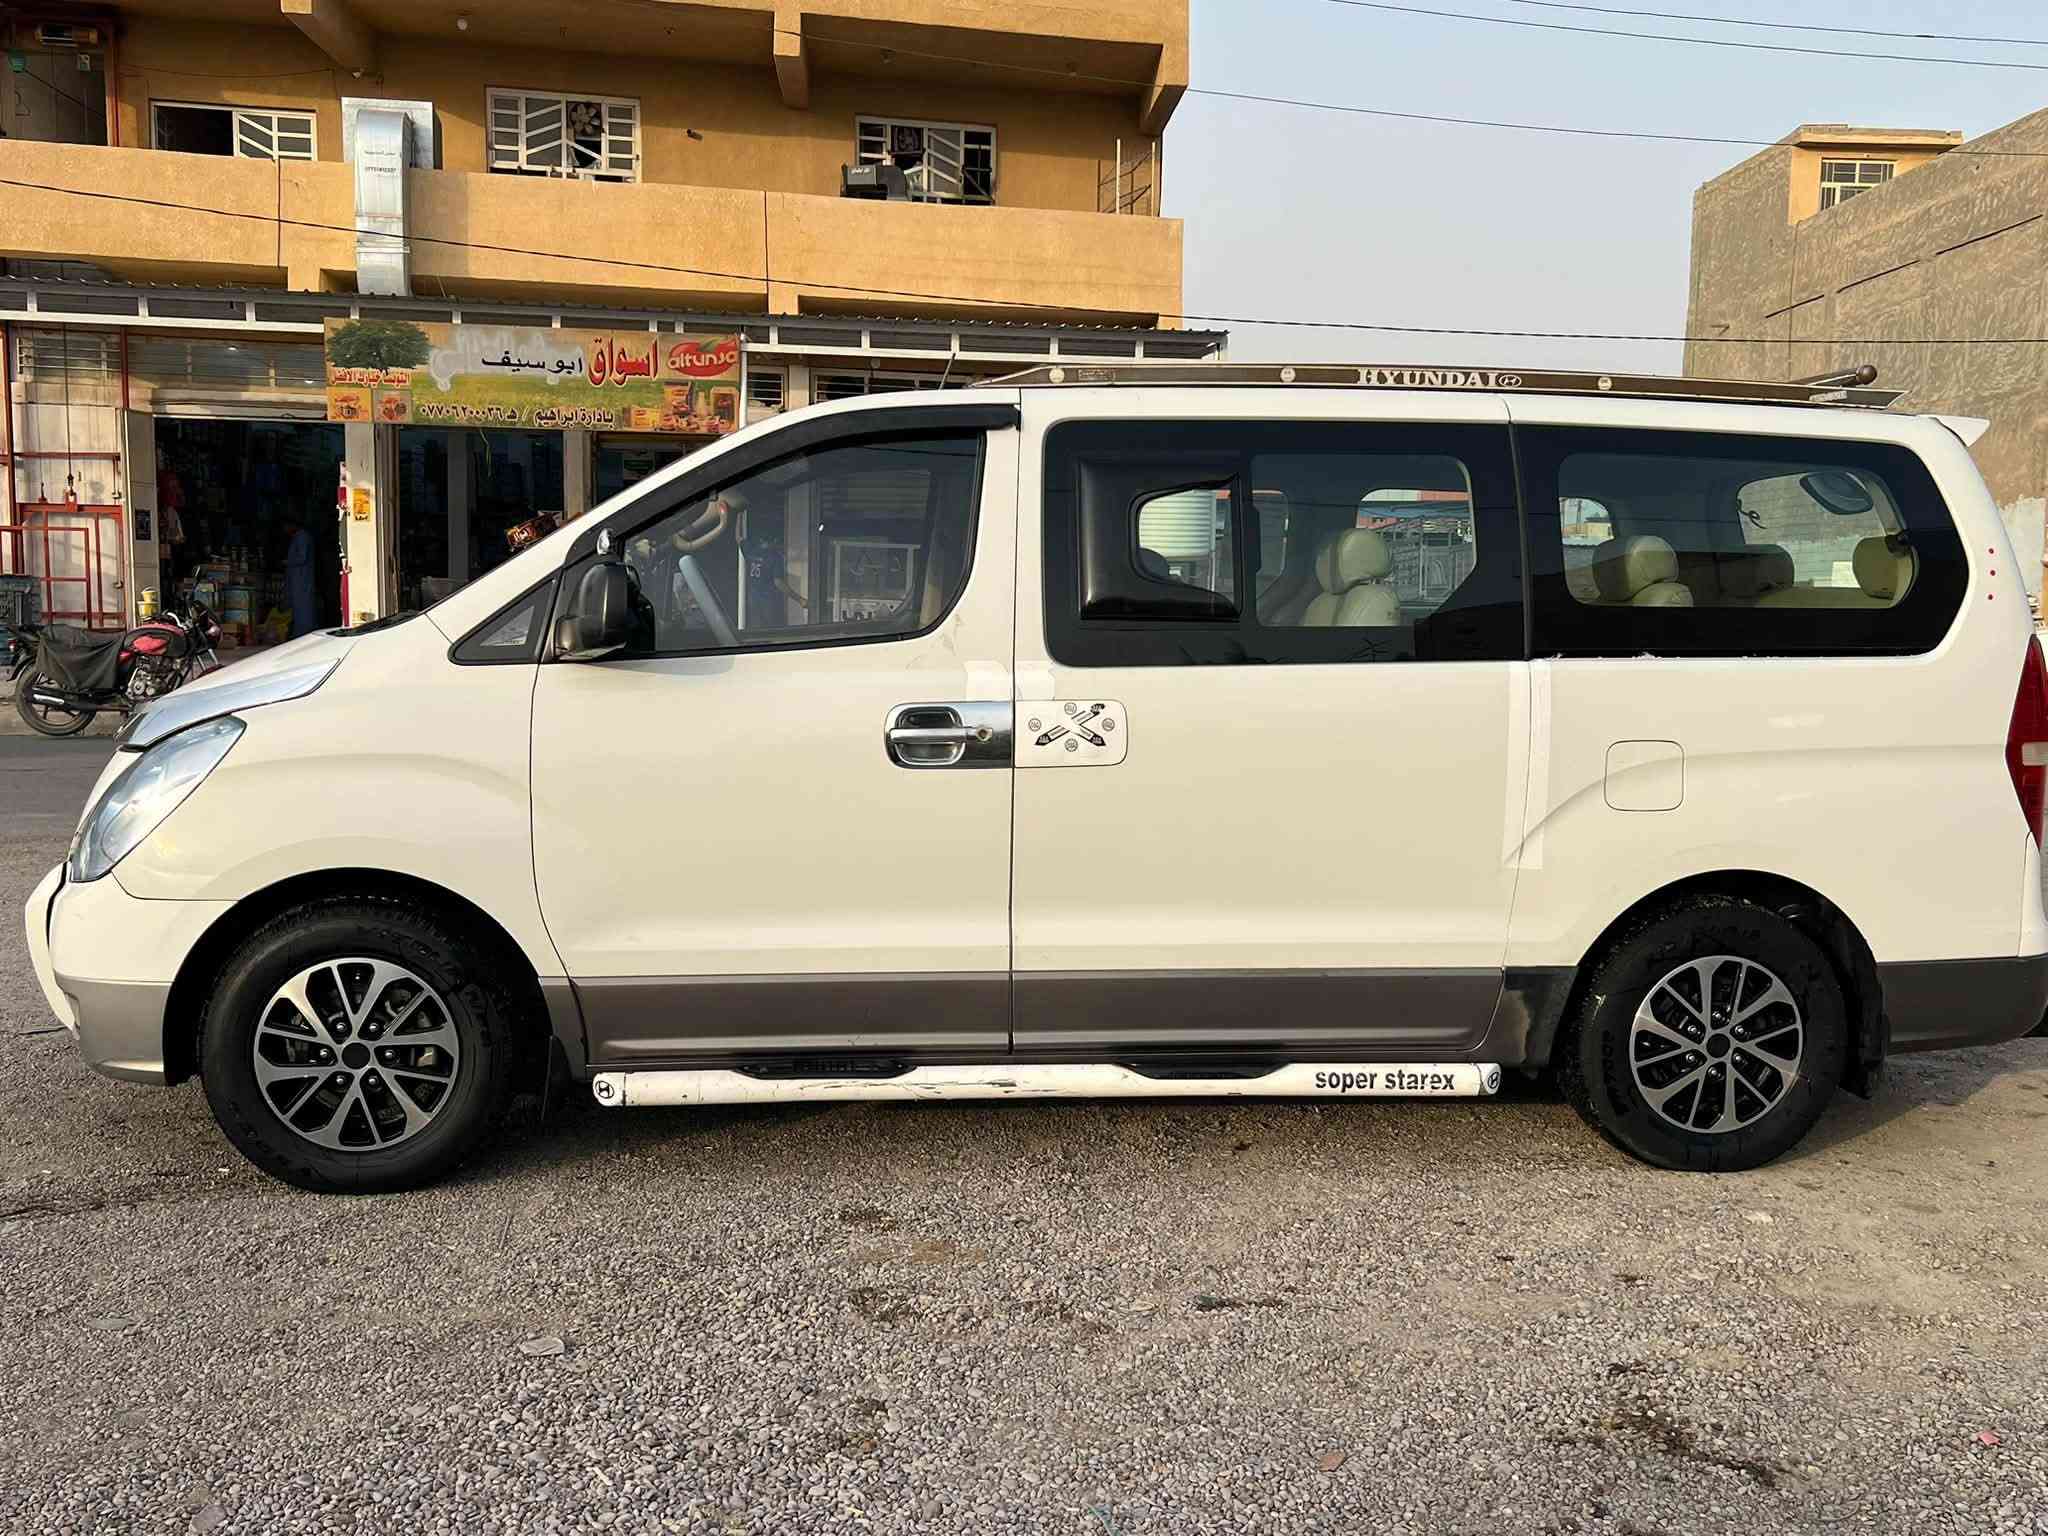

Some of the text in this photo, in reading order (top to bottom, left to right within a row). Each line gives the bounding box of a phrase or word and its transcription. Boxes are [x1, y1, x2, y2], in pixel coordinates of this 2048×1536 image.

[481, 335, 659, 386] اسواق ابو سيف
[1357, 367, 1500, 388] HYUNDAI
[535, 407, 578, 427] ابراهيم
[581, 408, 614, 427] بادارة
[1315, 1069, 1455, 1093] soper starex
